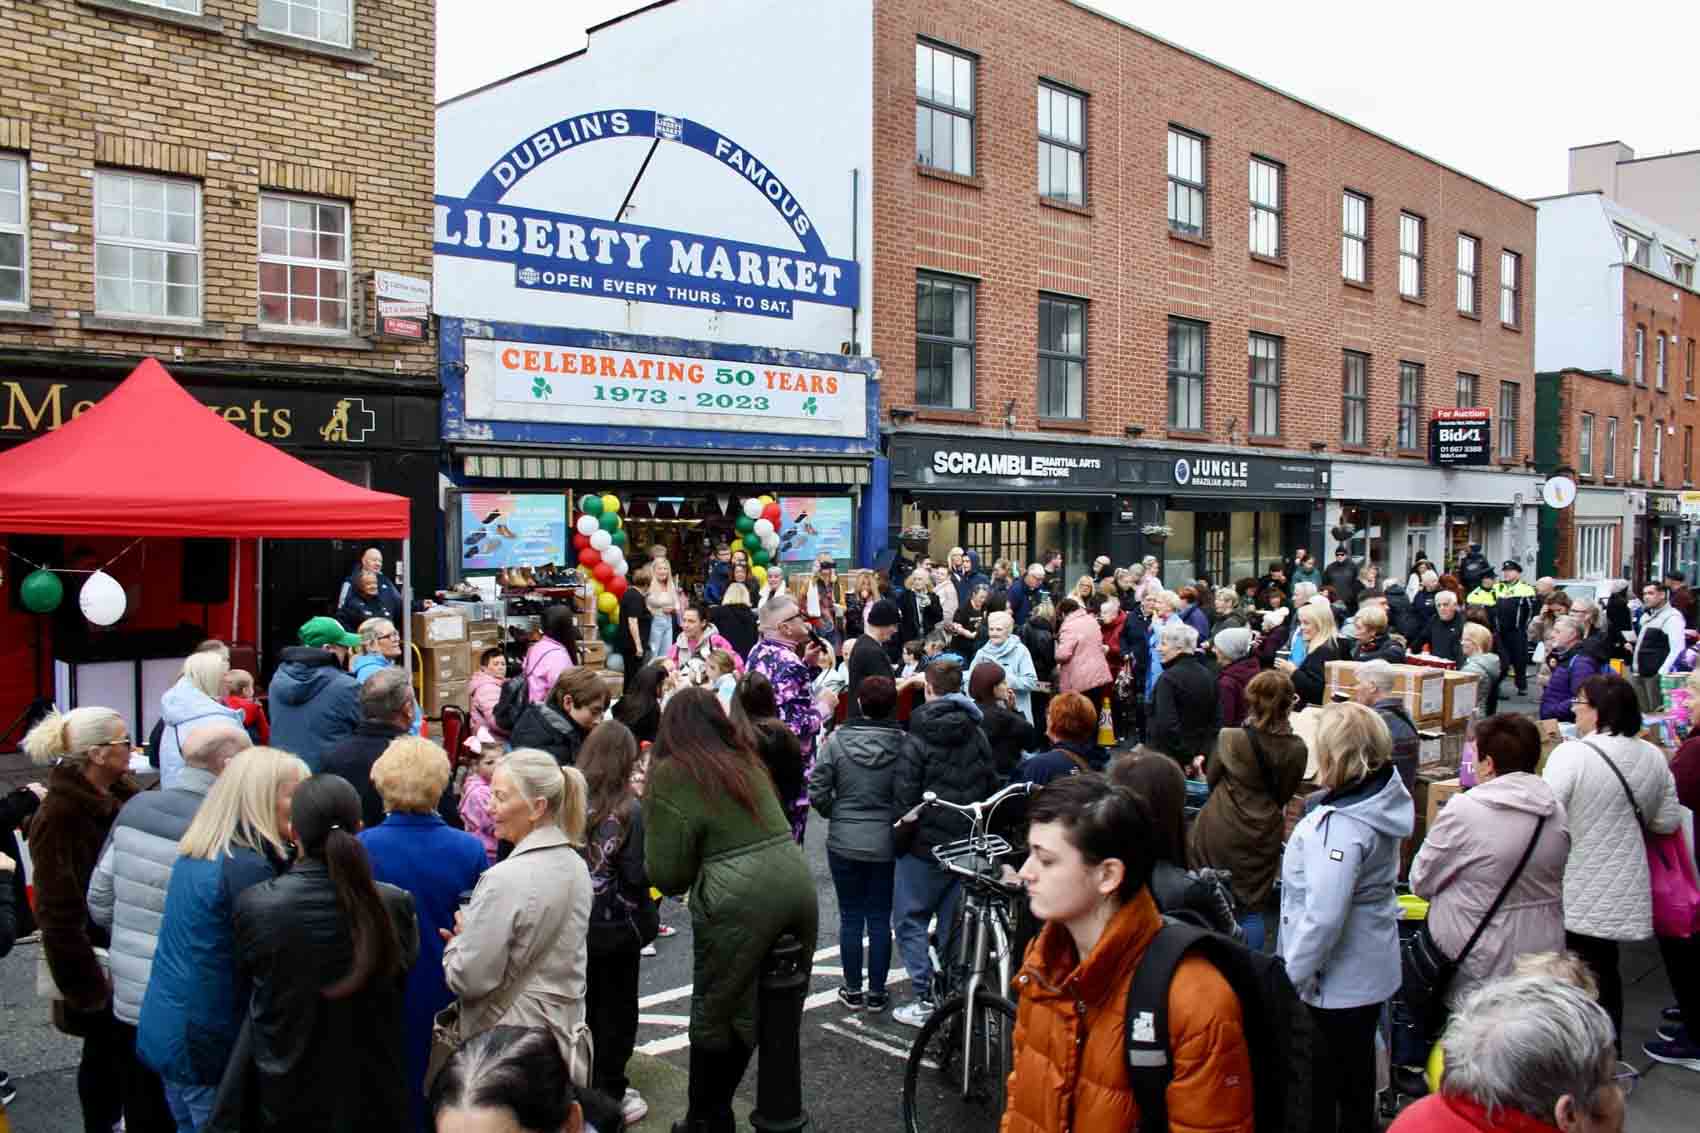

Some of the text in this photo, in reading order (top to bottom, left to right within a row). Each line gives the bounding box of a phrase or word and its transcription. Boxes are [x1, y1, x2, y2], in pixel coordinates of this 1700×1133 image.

[492, 111, 811, 237] DUBLIN'S FAMOUS
[432, 204, 841, 296] LIBERTY MARKET
[542, 271, 791, 314] OPEN EVERY THURS. TO SAT.
[501, 348, 838, 394] CELEBRATING 50 YEARS
[592, 384, 668, 404] 1973
[700, 392, 770, 410] 2023
[933, 451, 1101, 477] SCRAMBLE MARTIAL ARTS
[1042, 467, 1070, 477] STORE
[1192, 459, 1248, 478] JUNGLE
[1191, 478, 1222, 487] BRAZILIAN
